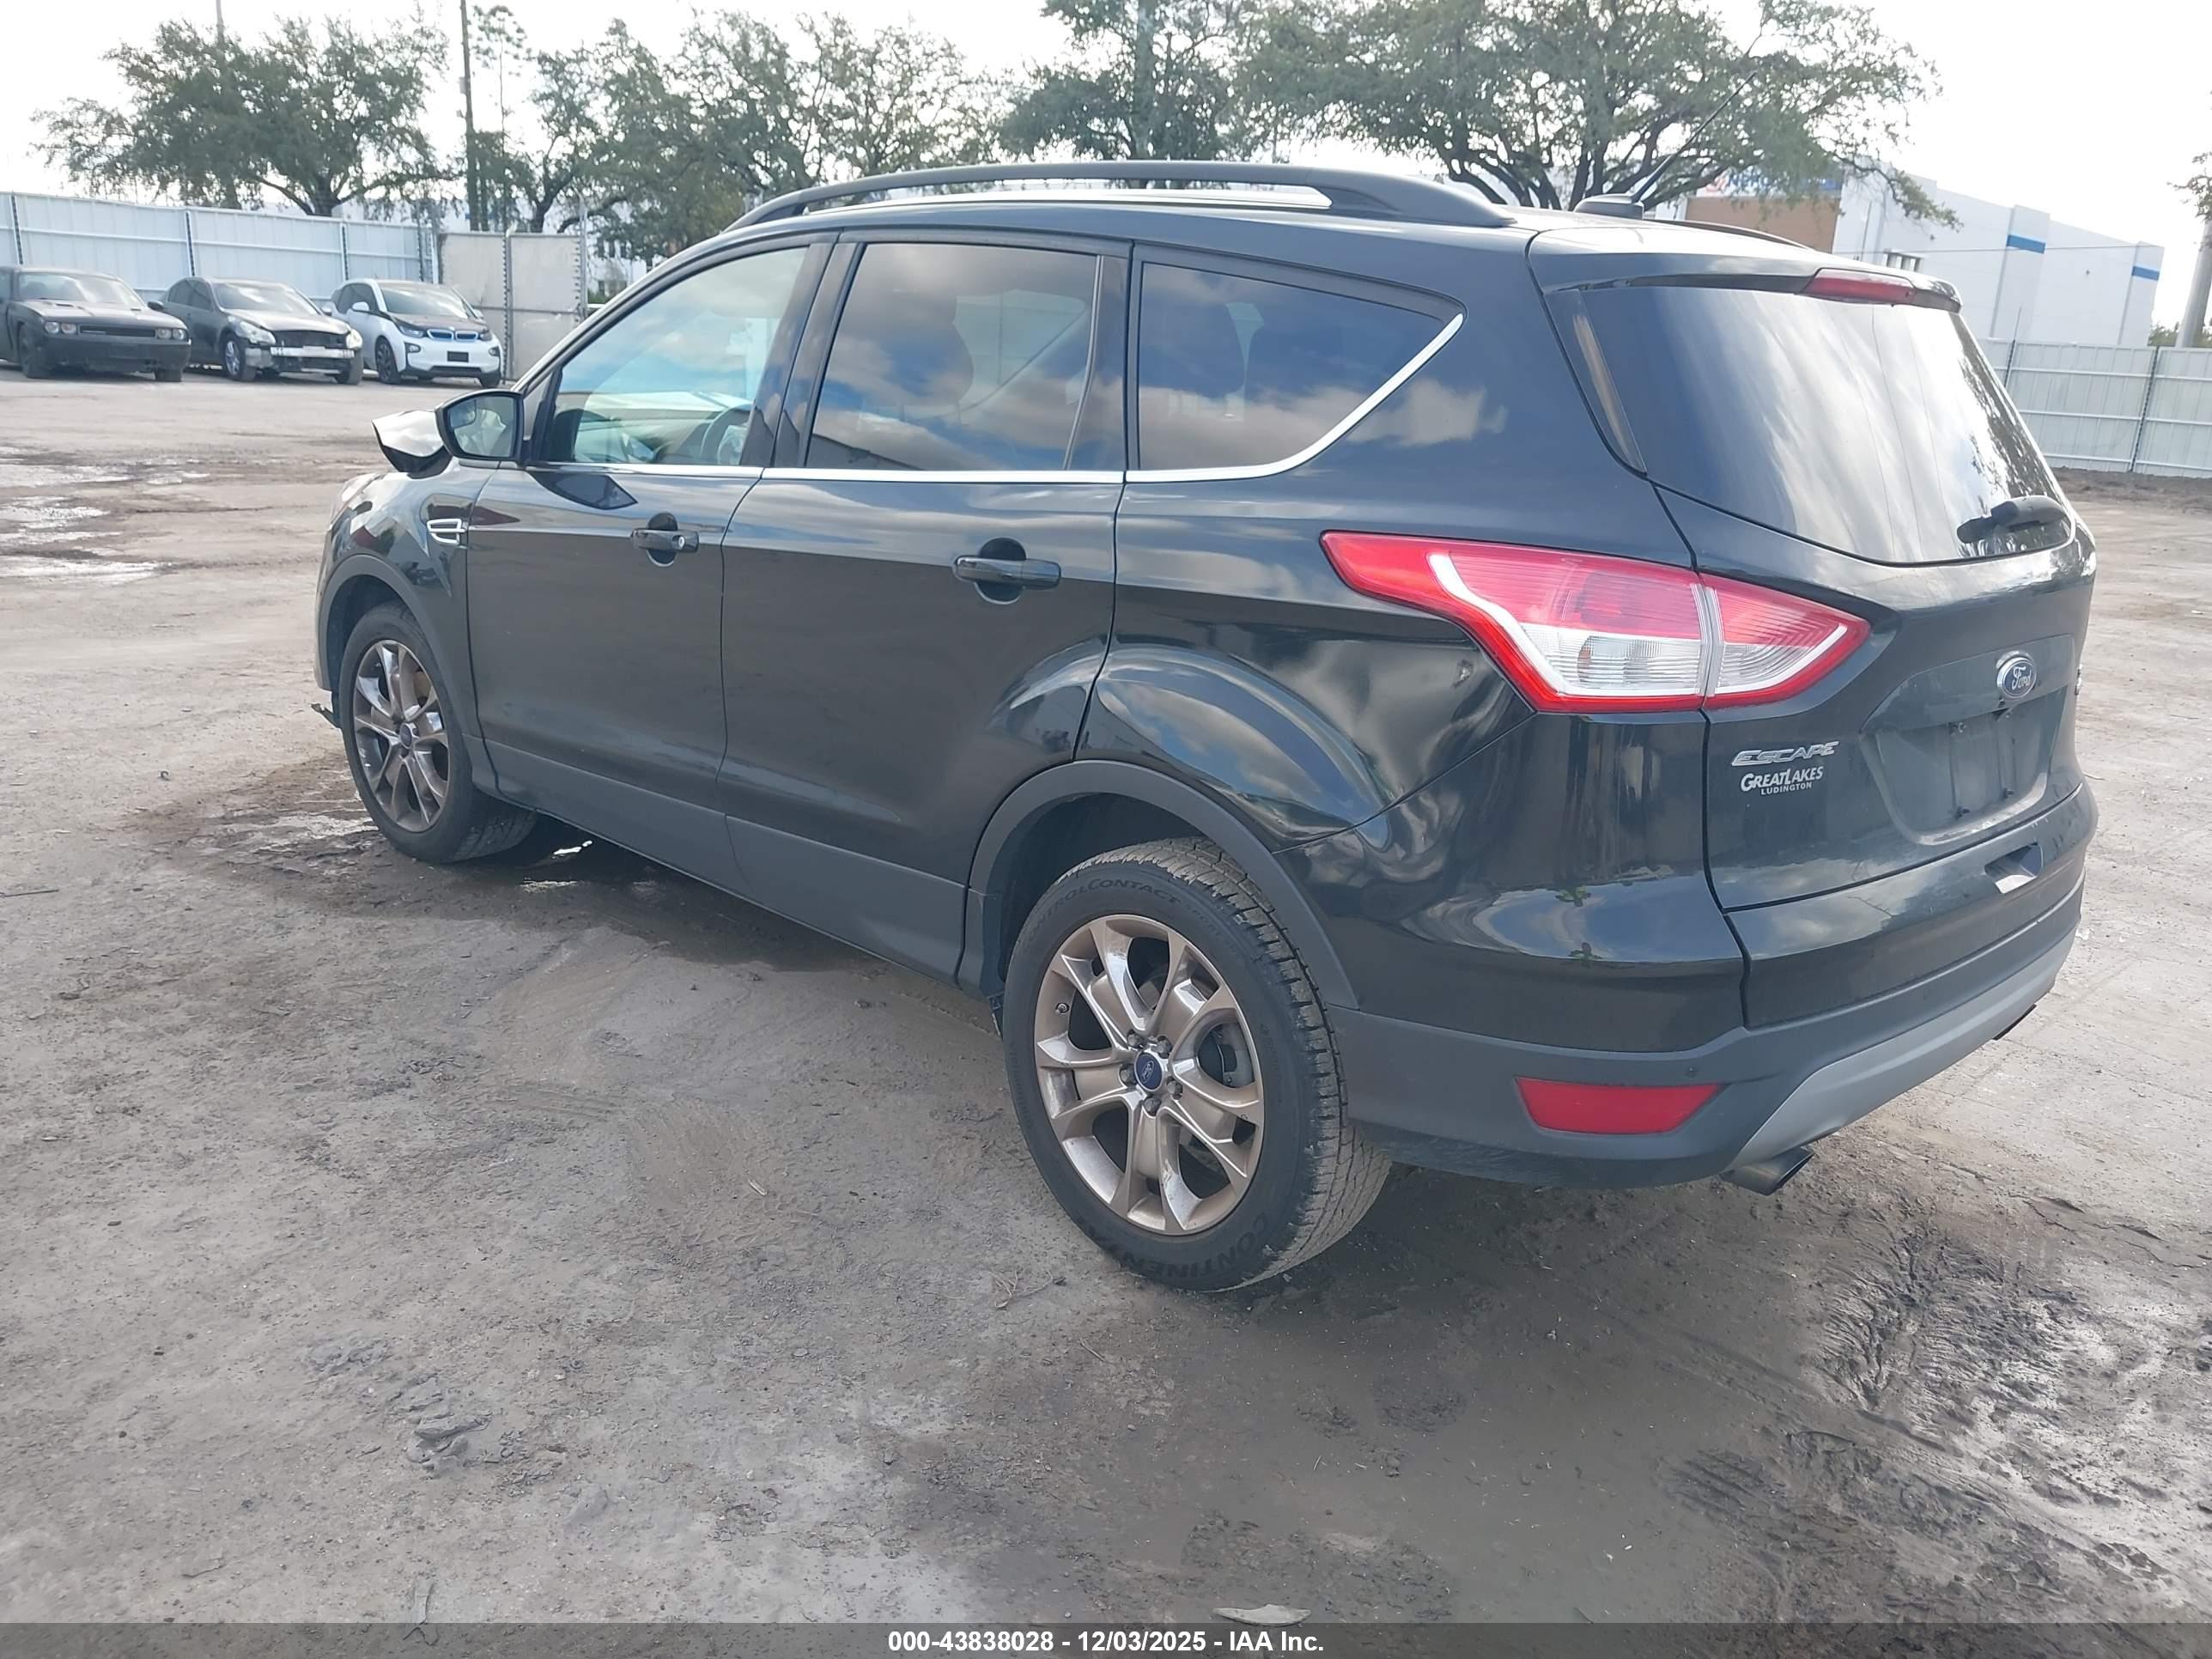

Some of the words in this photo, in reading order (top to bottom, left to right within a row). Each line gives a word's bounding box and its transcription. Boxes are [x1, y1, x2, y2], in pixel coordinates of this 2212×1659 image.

[2010, 665, 2033, 691] Ford
[1731, 740, 1840, 767] ESCAPE
[1760, 781, 1813, 796] LUDINGTON
